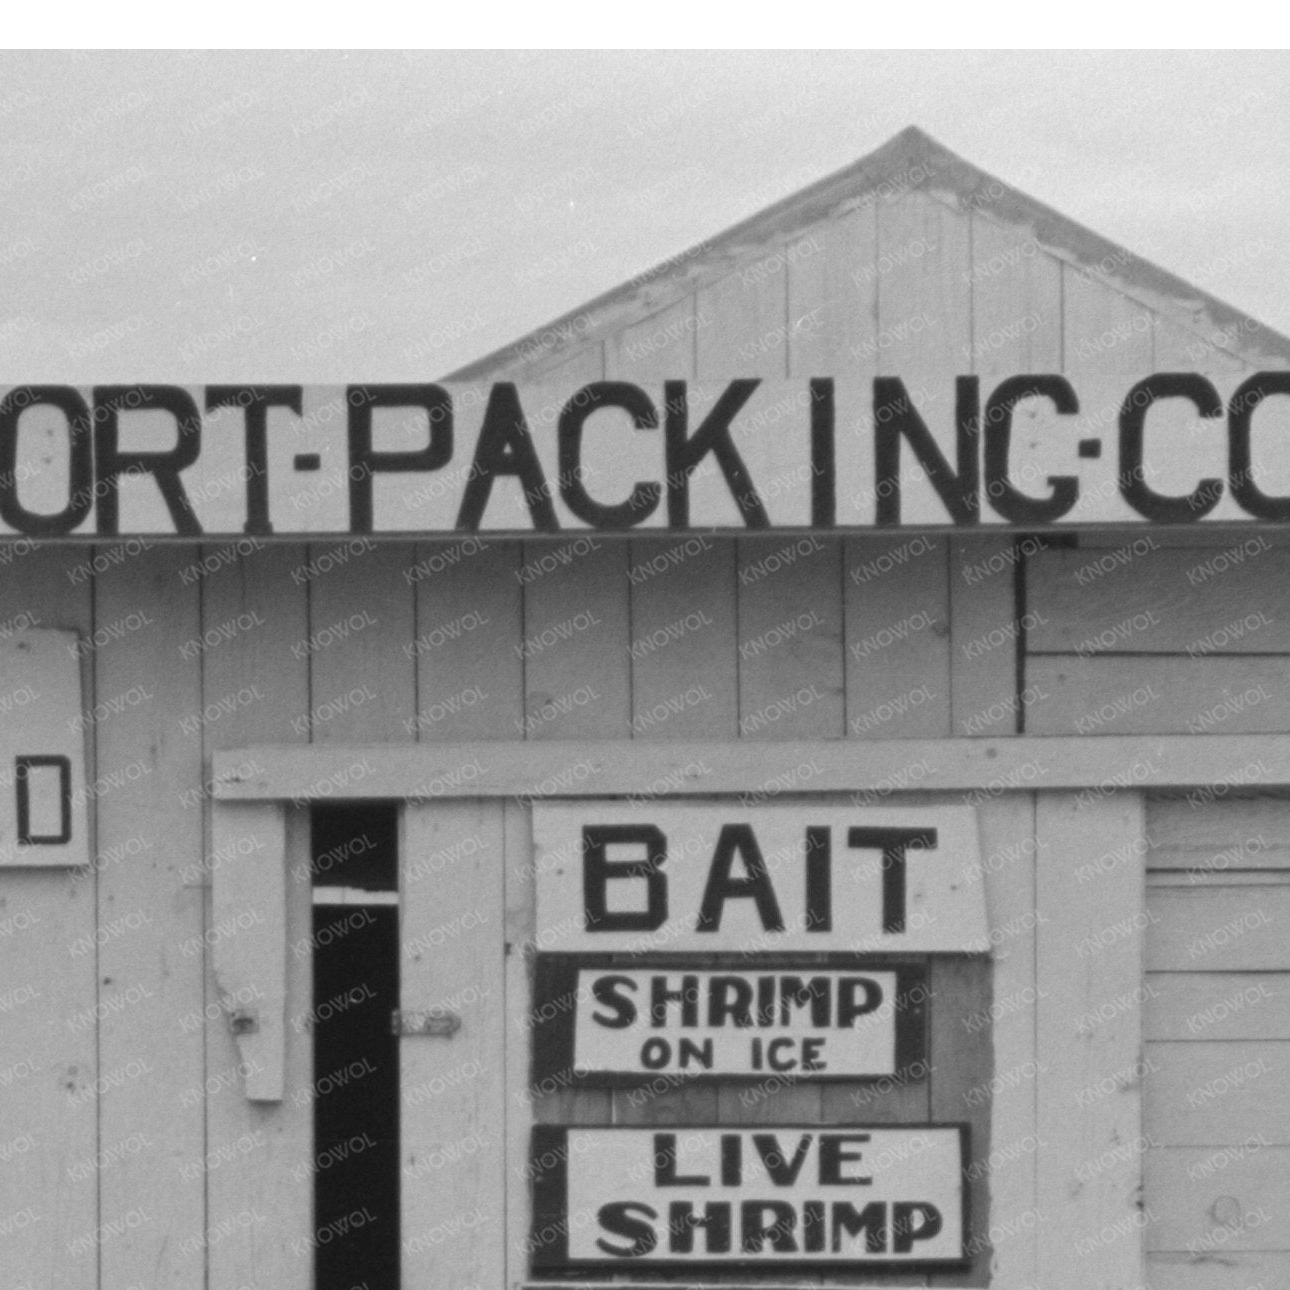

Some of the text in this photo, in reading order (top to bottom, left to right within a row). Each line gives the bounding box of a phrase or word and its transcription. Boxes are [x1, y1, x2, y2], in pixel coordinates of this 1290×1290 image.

[582, 823, 939, 934] BAIT
[591, 974, 885, 1029] SHRIMP
[640, 1037, 829, 1072] ON ICE
[654, 1133, 873, 1187] LIVE
[595, 1200, 944, 1258] SHRIMP
